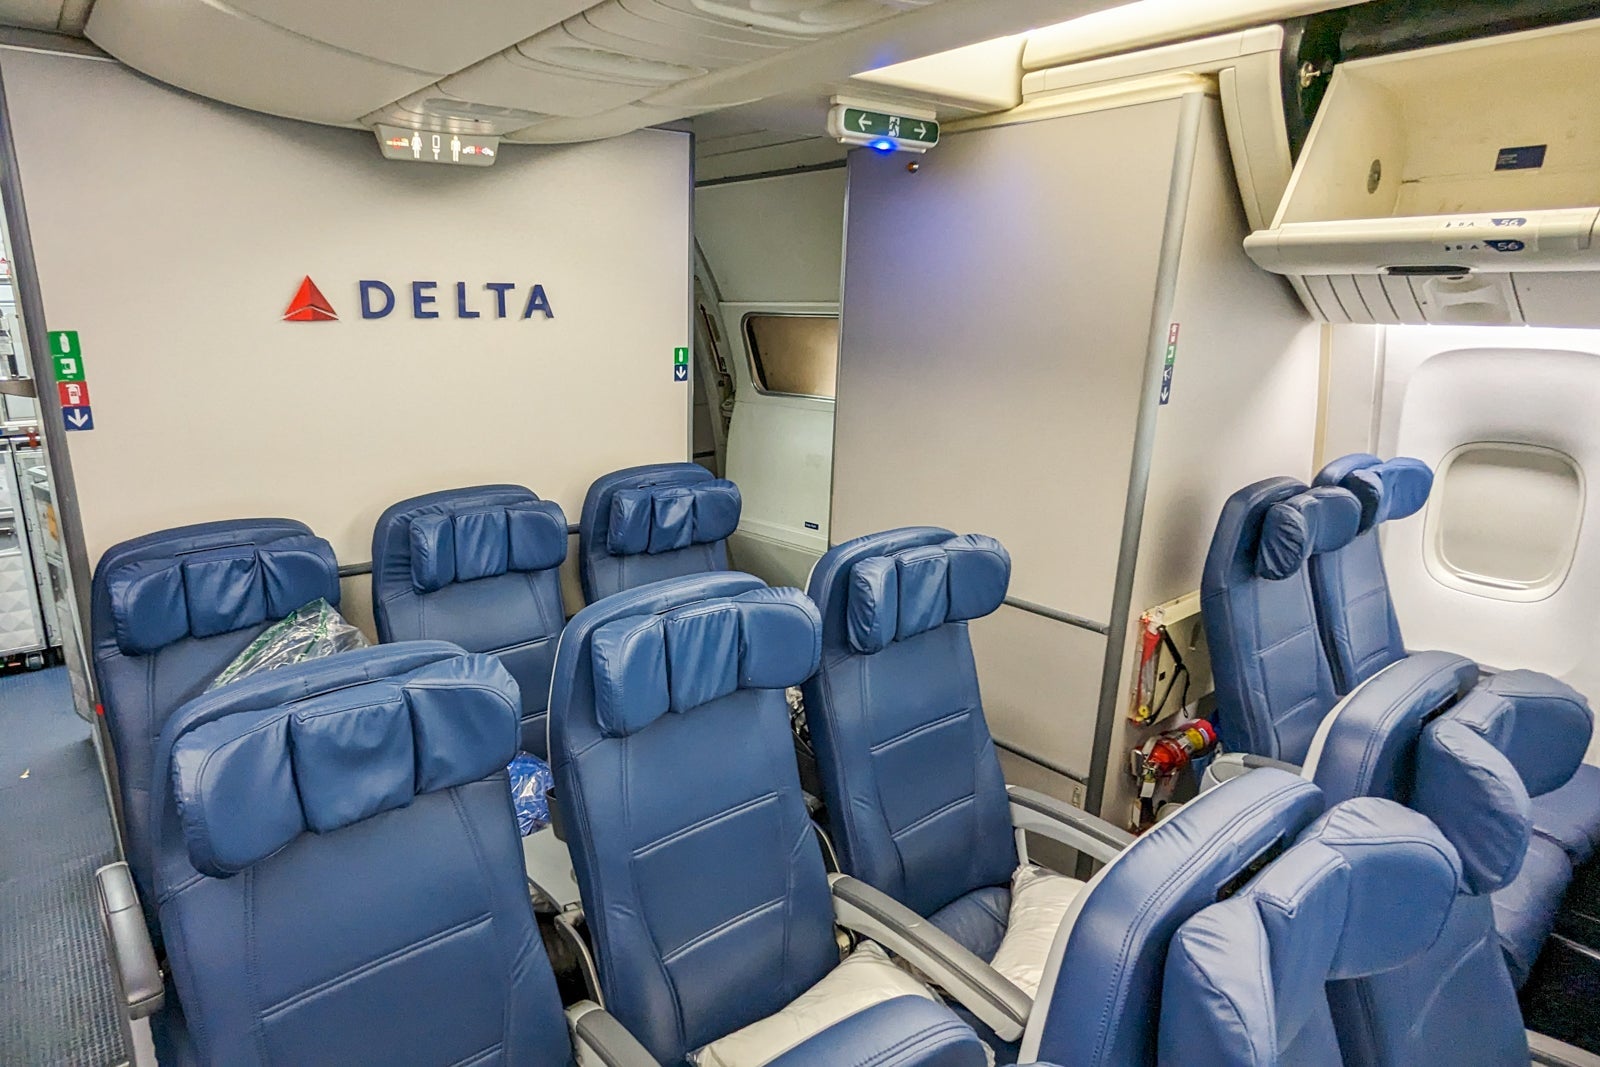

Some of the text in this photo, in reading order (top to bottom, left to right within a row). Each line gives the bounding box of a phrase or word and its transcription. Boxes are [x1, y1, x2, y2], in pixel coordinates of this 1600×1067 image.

[1500, 218, 1519, 226] 56
[1497, 242, 1518, 250] 56
[359, 280, 554, 319] DELTA
